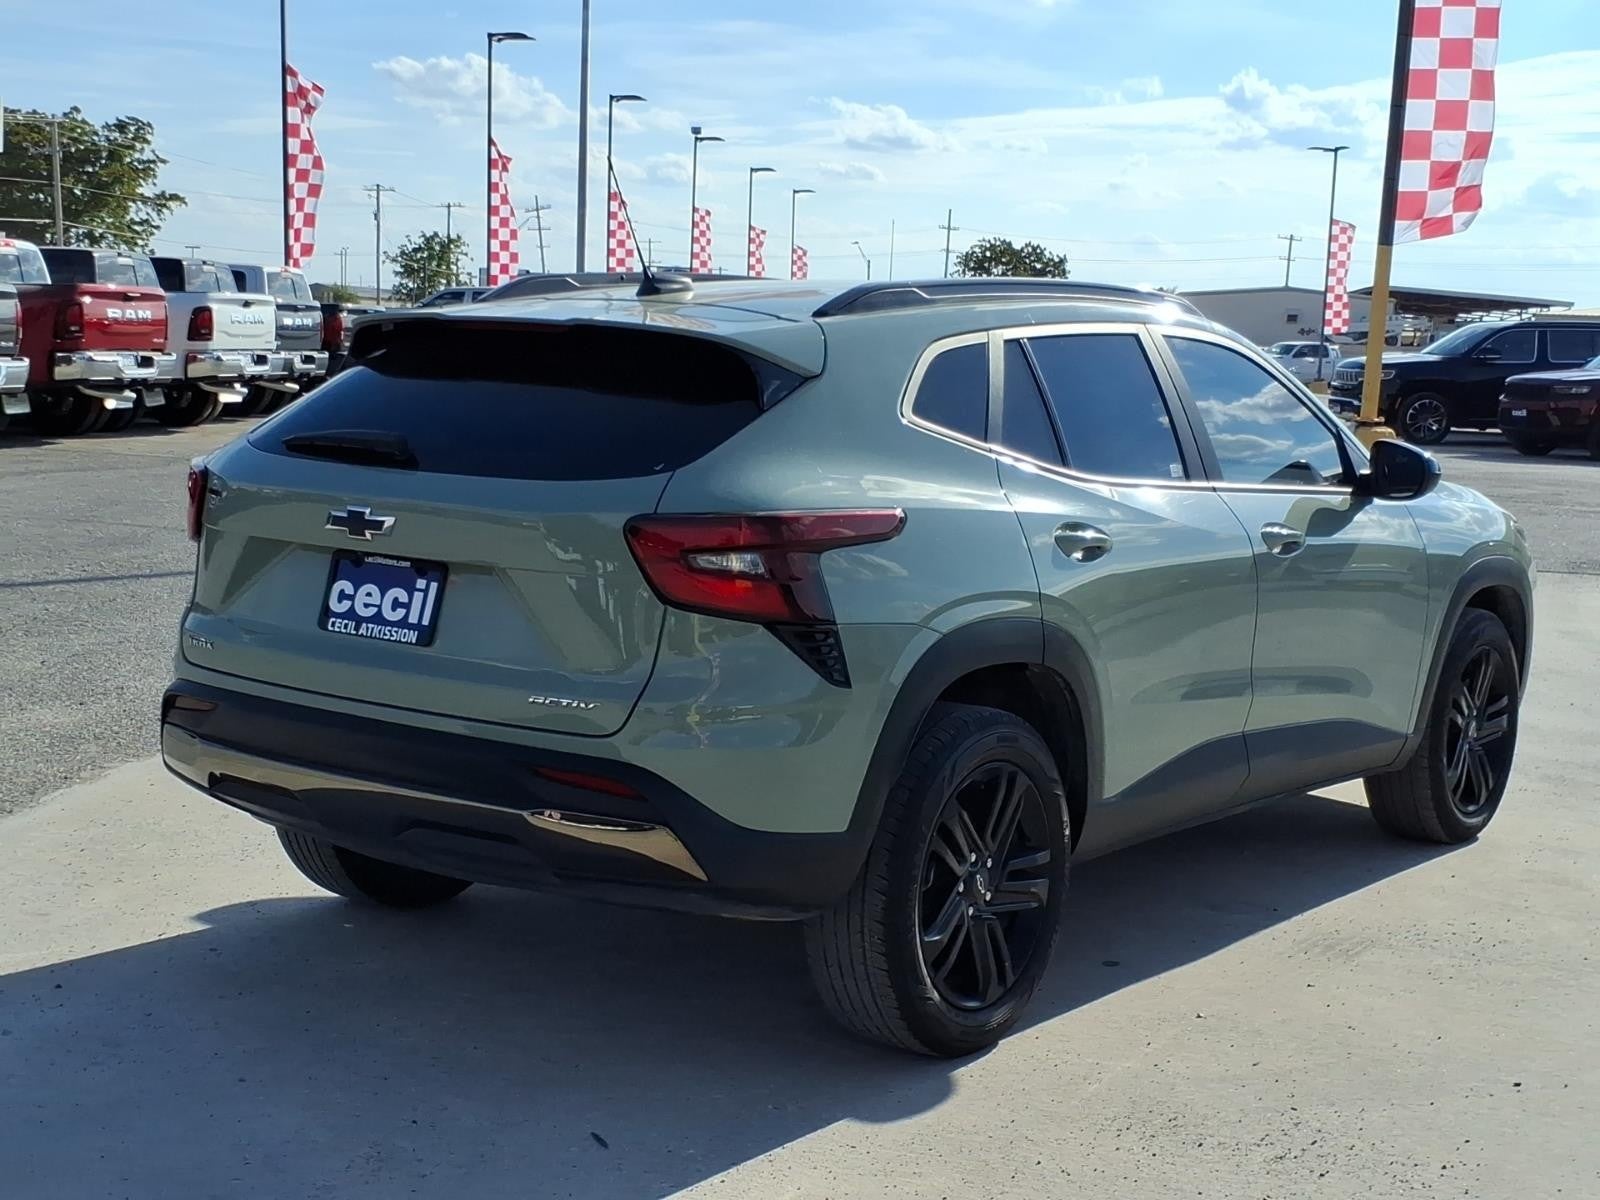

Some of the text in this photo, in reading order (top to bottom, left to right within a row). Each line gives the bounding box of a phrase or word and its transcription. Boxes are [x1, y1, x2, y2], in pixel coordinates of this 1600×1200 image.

[106, 308, 152, 320] RAM
[231, 313, 264, 325] RAM
[328, 578, 439, 626] cecil
[327, 617, 419, 644] CECIL ATKISSION
[528, 695, 601, 711] ACTIV
